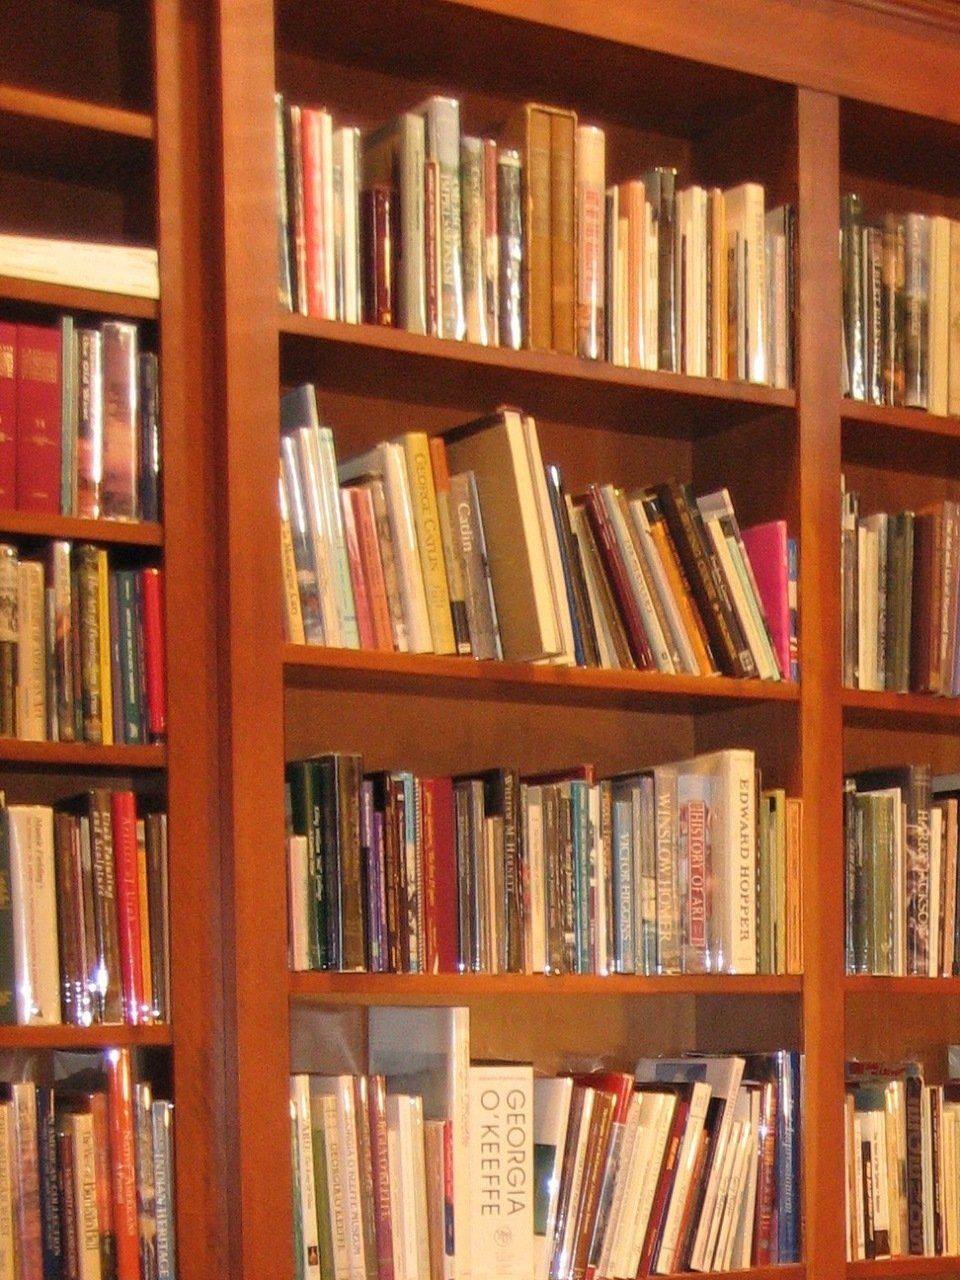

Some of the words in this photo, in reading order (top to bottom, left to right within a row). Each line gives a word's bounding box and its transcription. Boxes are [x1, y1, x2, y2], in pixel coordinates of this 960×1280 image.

[414, 453, 429, 512] GEORGE
[423, 519, 438, 572] CATLIN
[457, 502, 475, 553] Catlin
[503, 774, 514, 820] WILLIAM
[739, 779, 750, 859] EDWARD
[620, 832, 632, 881] VICTOR
[658, 793, 673, 875] WINSLOW
[690, 811, 704, 869] HISTORY
[102, 845, 114, 900] Painting
[504, 842, 516, 895] HARNETT
[690, 875, 704, 892] OF
[620, 884, 633, 941] HIGGINS
[658, 880, 674, 943] HOMER
[690, 898, 704, 922] ART
[739, 864, 750, 942] HOPPER
[154, 1153, 166, 1204] INDIAN
[480, 1089, 501, 1217] O'KEEFFE
[506, 1088, 527, 1217] GEORGIA
[82, 1181, 98, 1229] Buffalo
[84, 1229, 99, 1251] Bill
[155, 1207, 170, 1279] HERITAGE
